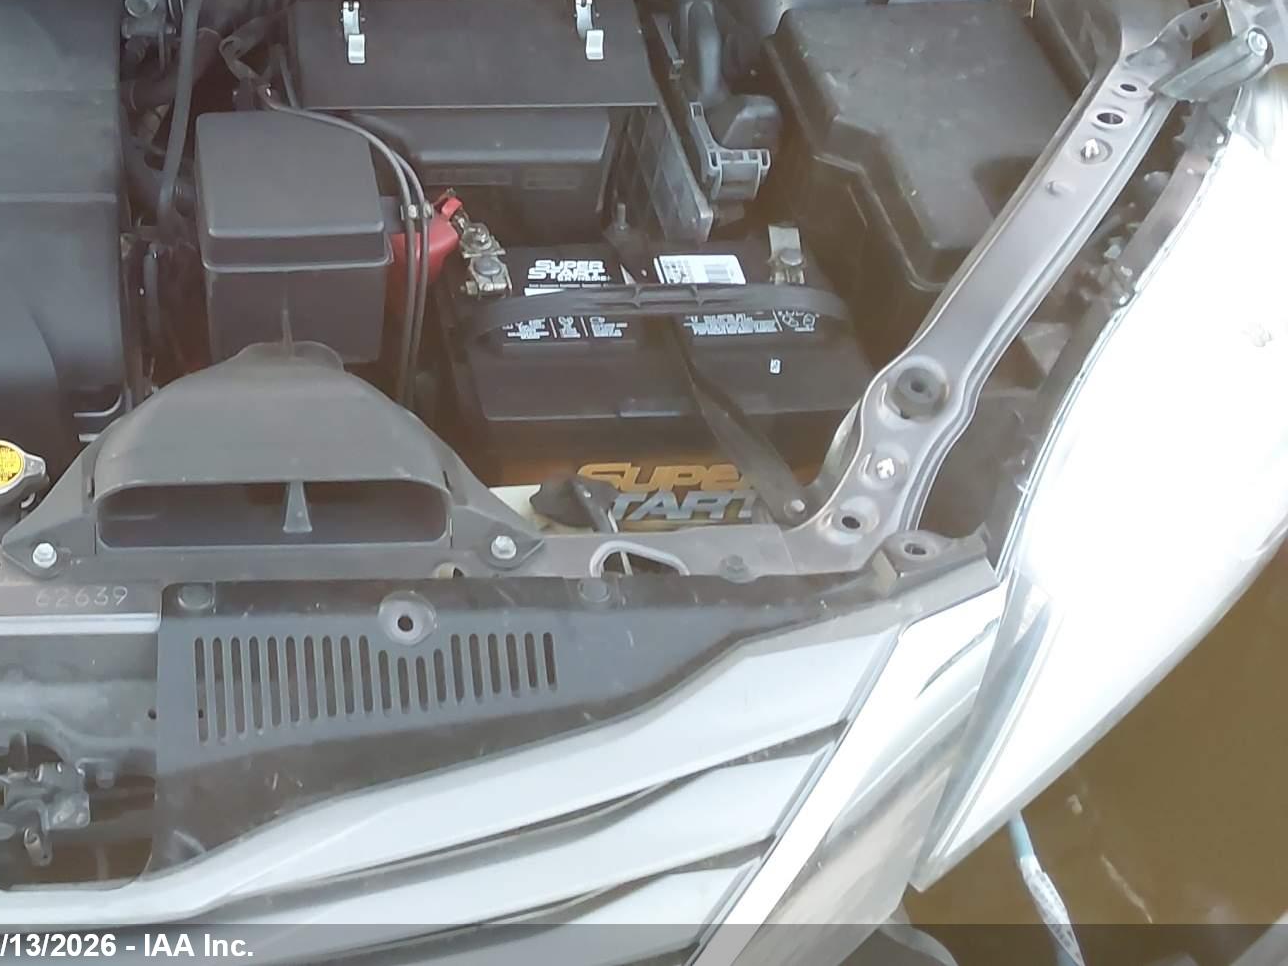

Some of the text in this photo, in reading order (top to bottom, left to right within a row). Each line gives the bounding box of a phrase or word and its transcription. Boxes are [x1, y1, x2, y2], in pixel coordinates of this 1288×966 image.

[527, 267, 606, 280] START
[534, 259, 603, 272] SUPER
[577, 462, 750, 492] SUPE
[612, 489, 760, 521] TART
